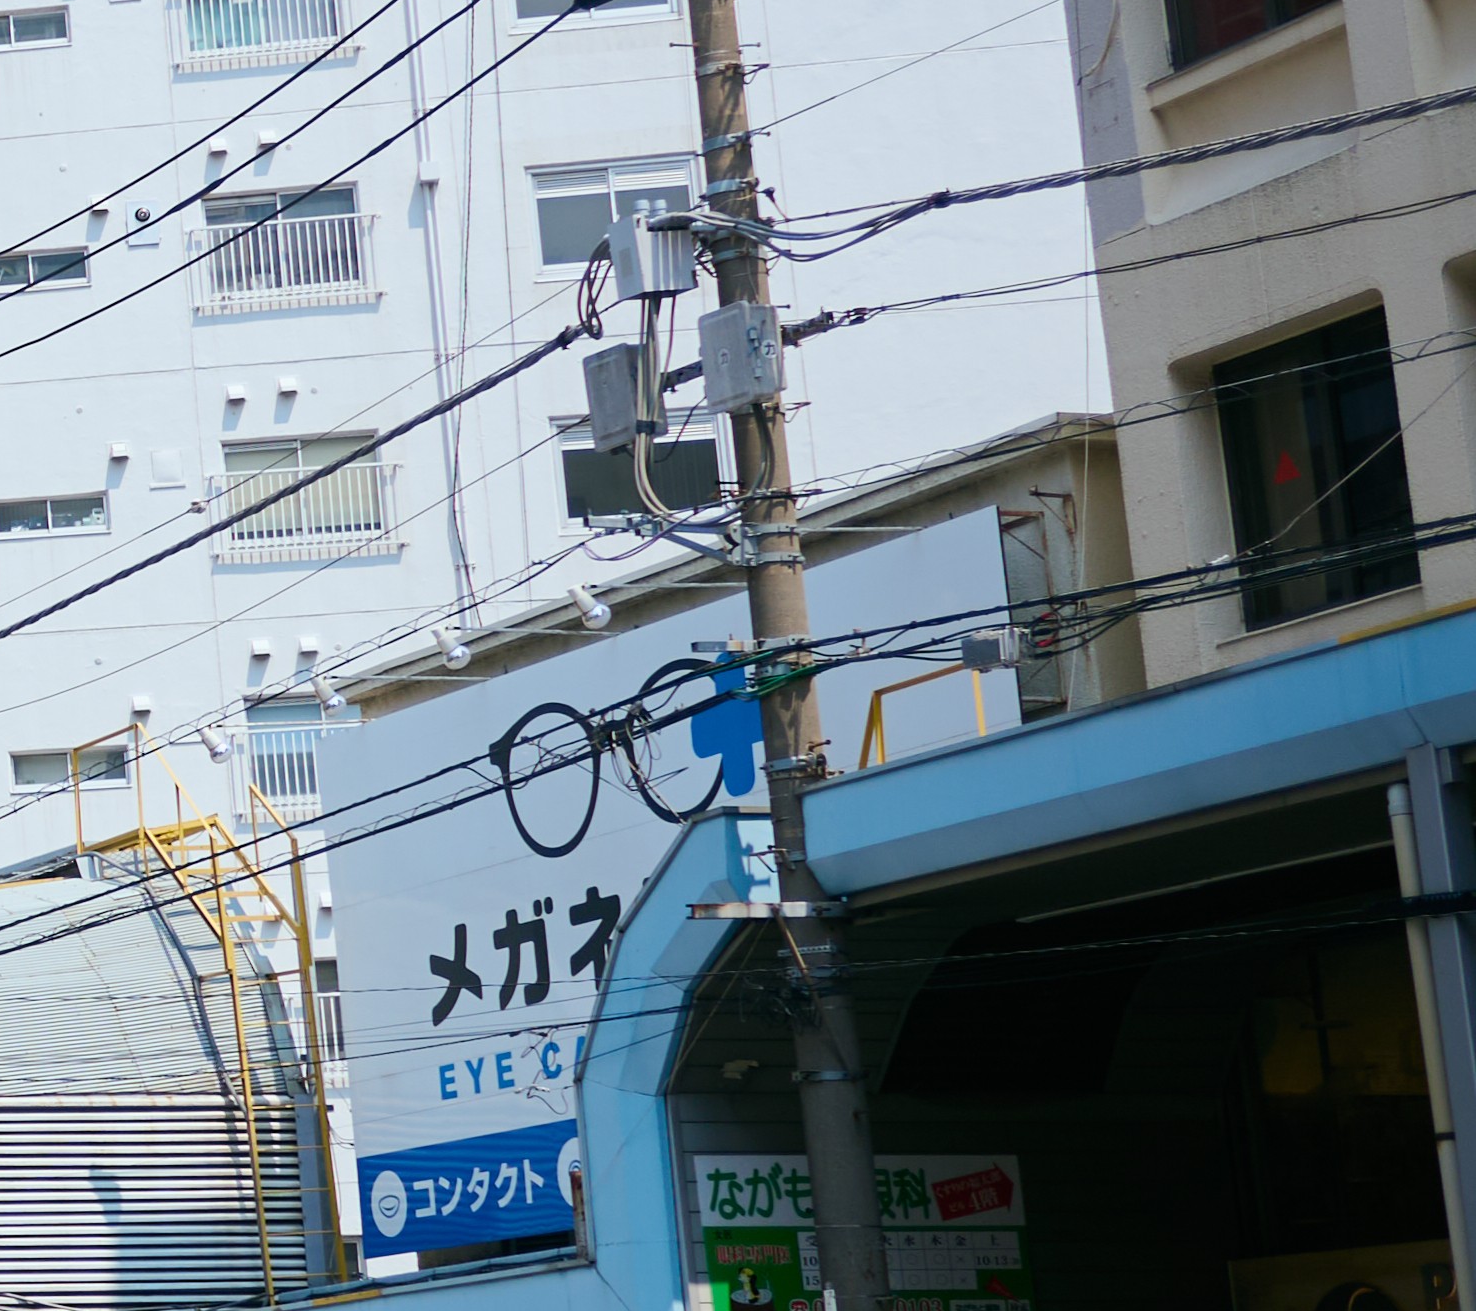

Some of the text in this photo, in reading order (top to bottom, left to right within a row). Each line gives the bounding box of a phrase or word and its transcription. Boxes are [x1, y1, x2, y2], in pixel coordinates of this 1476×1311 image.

[438, 1049, 515, 1101] EYE
[413, 1157, 545, 1220] コンタクト
